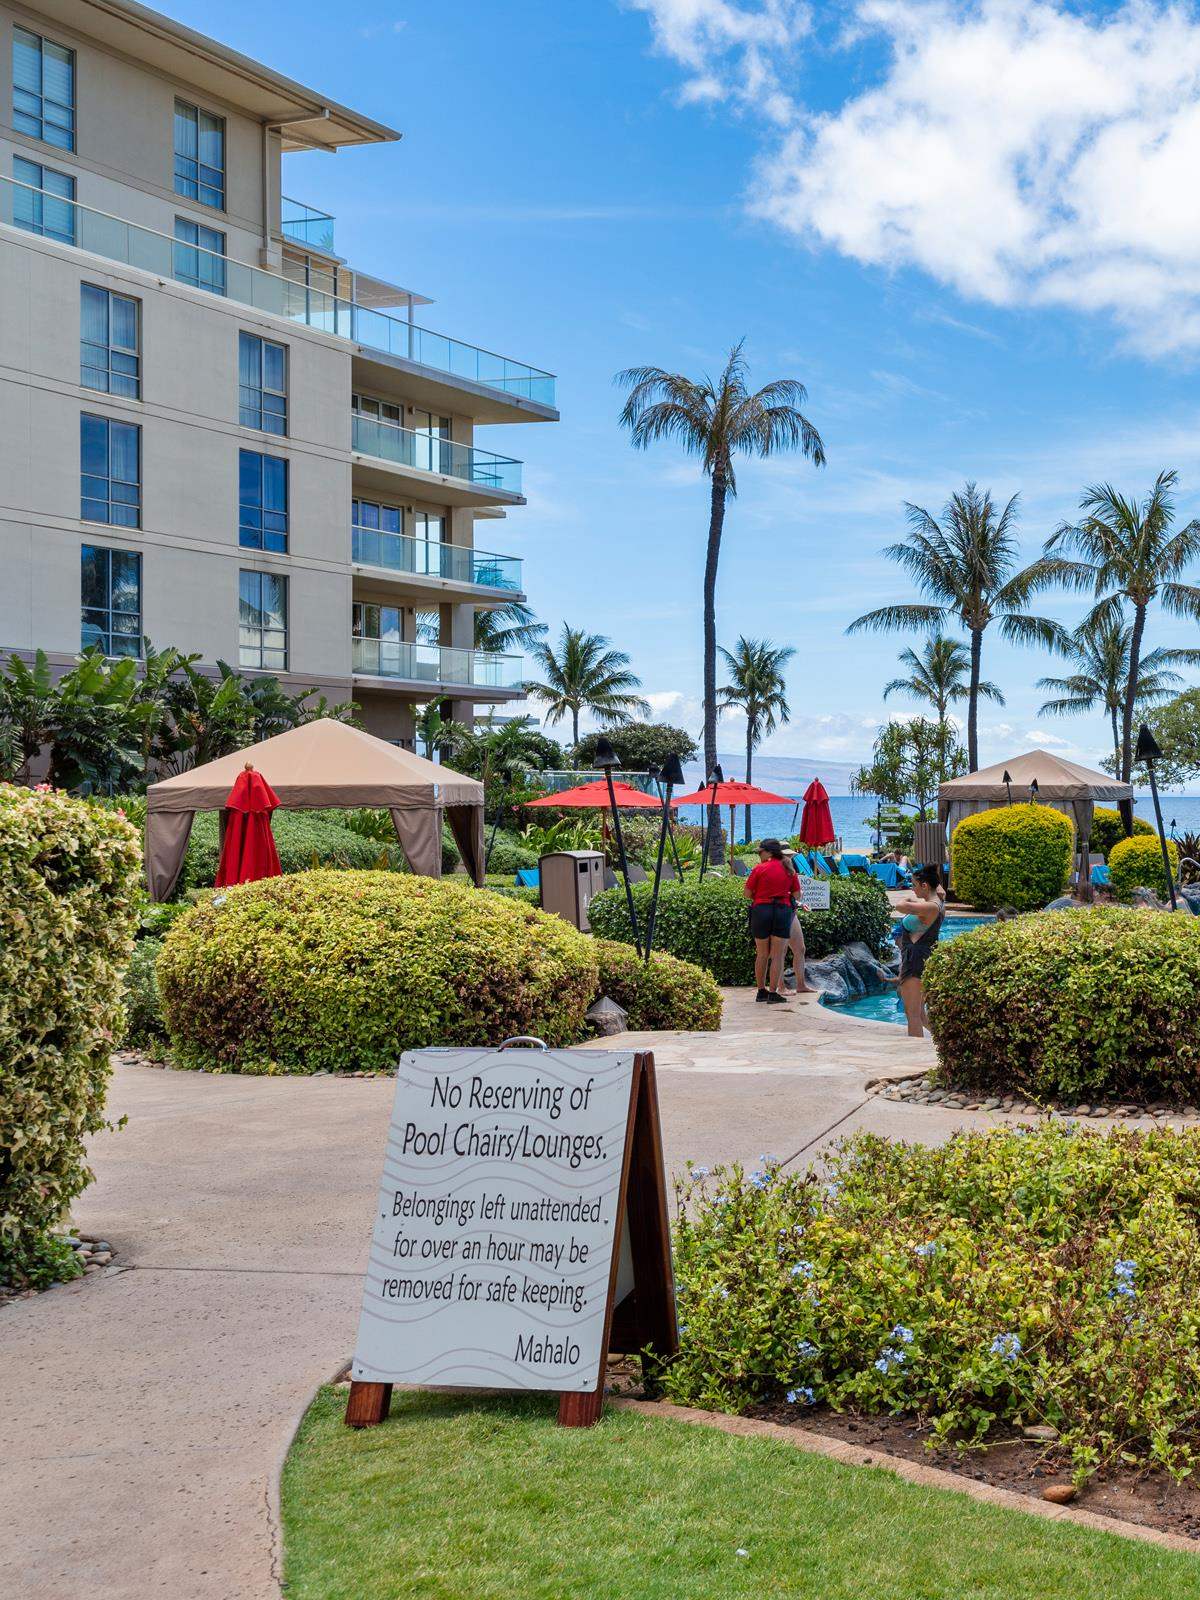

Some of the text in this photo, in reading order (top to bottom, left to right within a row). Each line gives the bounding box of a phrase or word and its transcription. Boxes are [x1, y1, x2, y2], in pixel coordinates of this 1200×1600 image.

[430, 1076, 595, 1120] No Reserving of
[402, 1122, 607, 1169] Pool Chairs/Lounges.
[392, 1190, 602, 1227] Belongings left unattended
[393, 1230, 589, 1270] for over an hour may be
[381, 1273, 588, 1314] removed for safe keeping.
[514, 1334, 581, 1365] Mahalo
